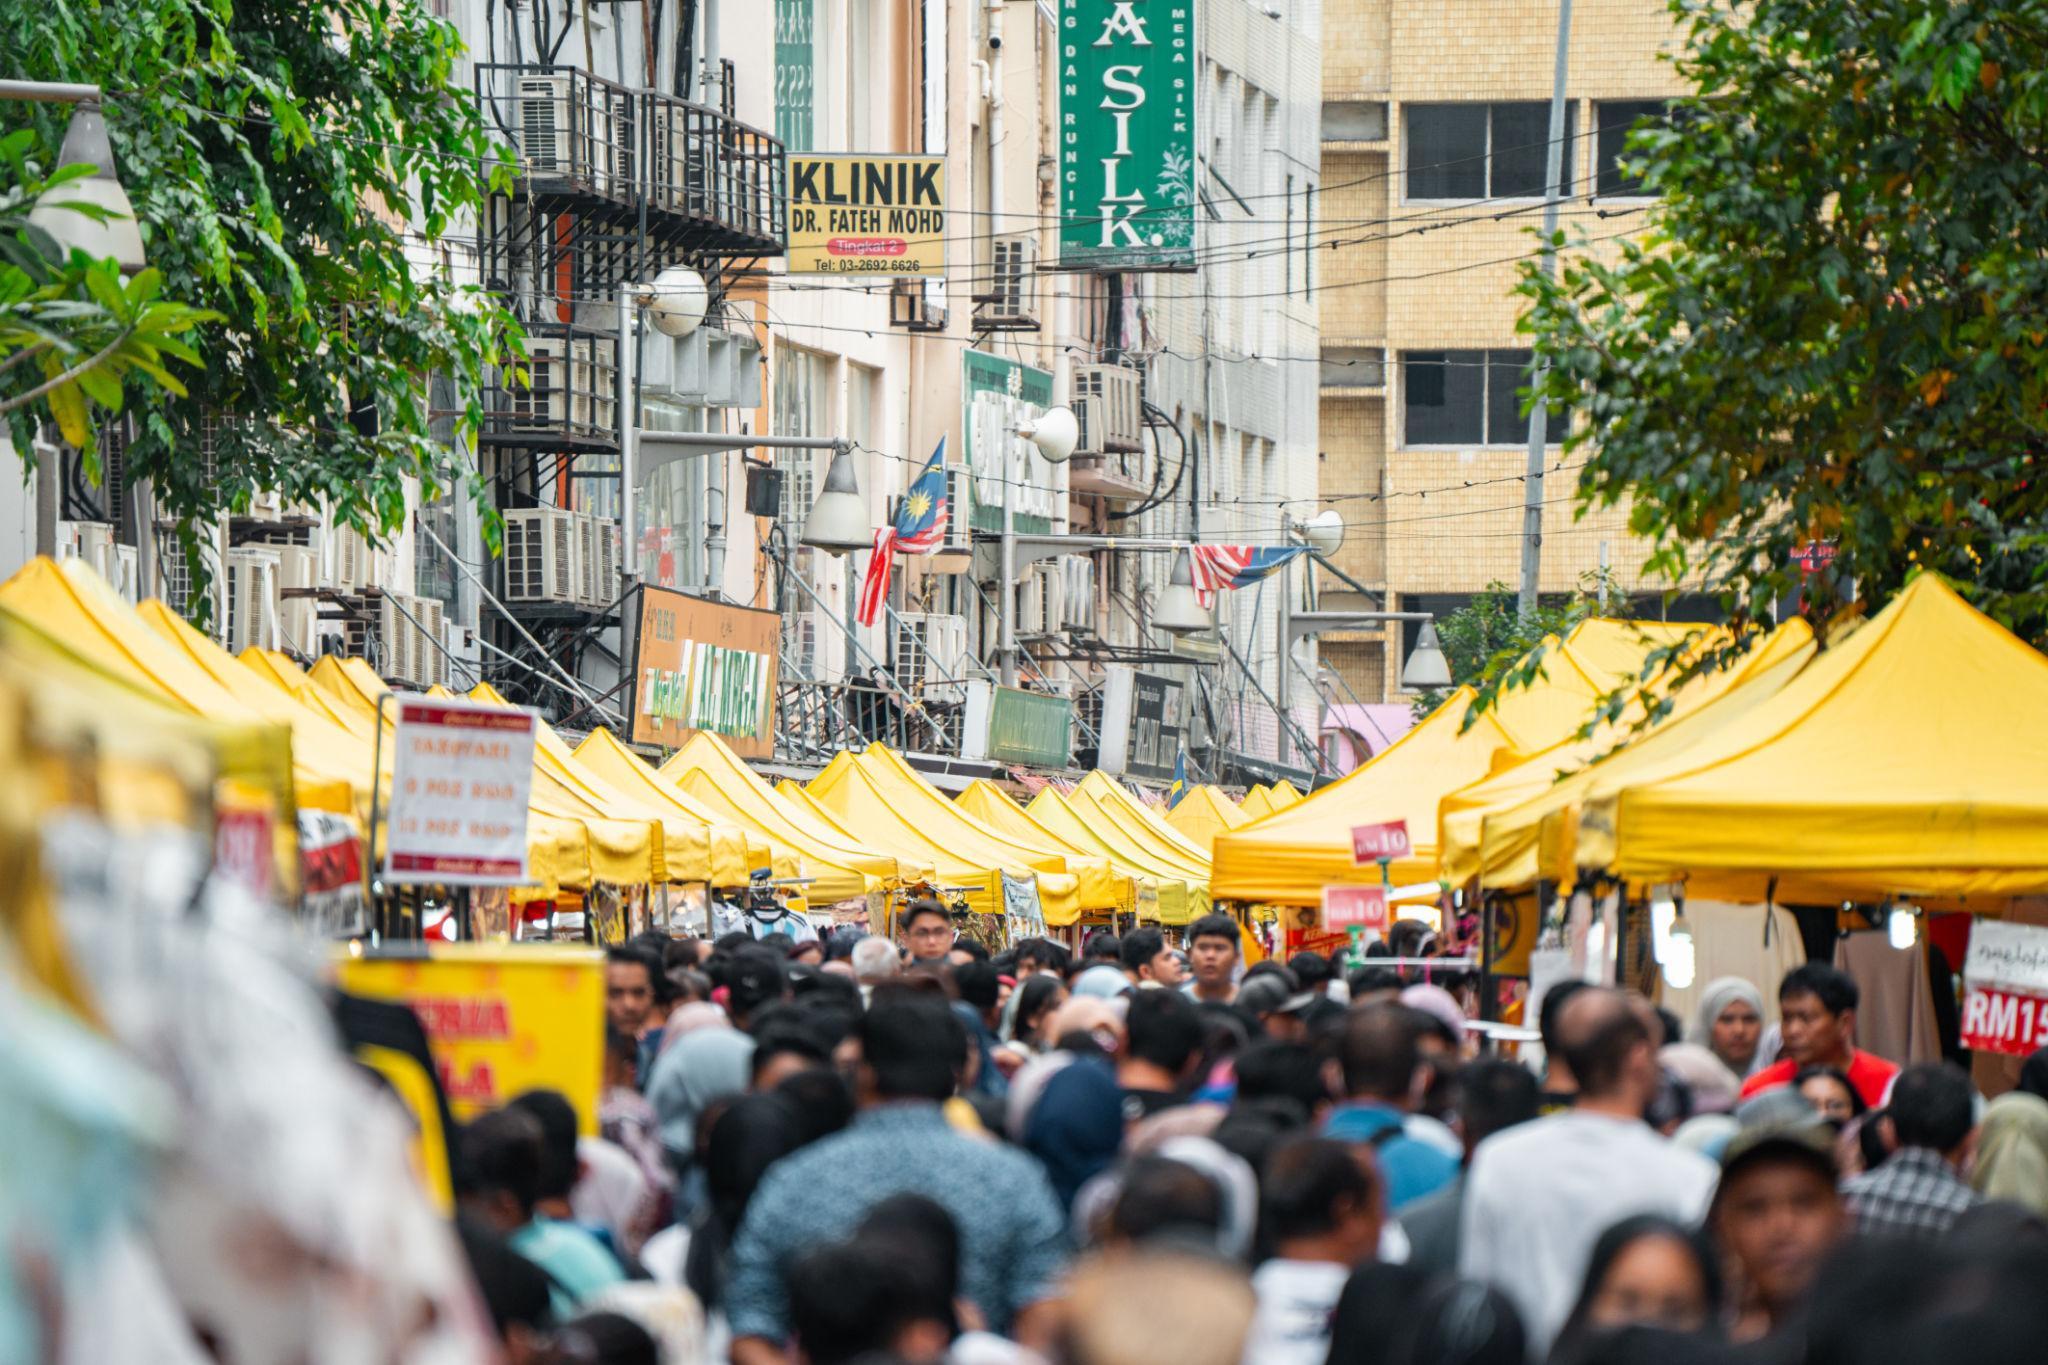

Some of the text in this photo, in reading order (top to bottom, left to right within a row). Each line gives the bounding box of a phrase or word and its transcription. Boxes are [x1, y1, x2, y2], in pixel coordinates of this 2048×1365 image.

[1065, 45, 1076, 96] DAN
[1172, 9, 1186, 132] MEGA SILK
[792, 161, 942, 206] KLINIK
[1064, 113, 1077, 220] RUNCIT
[792, 208, 944, 234] DR. FATEH MOHD
[814, 259, 920, 272] Tel: 03-2692 6626
[835, 239, 898, 255] Tingkat 2
